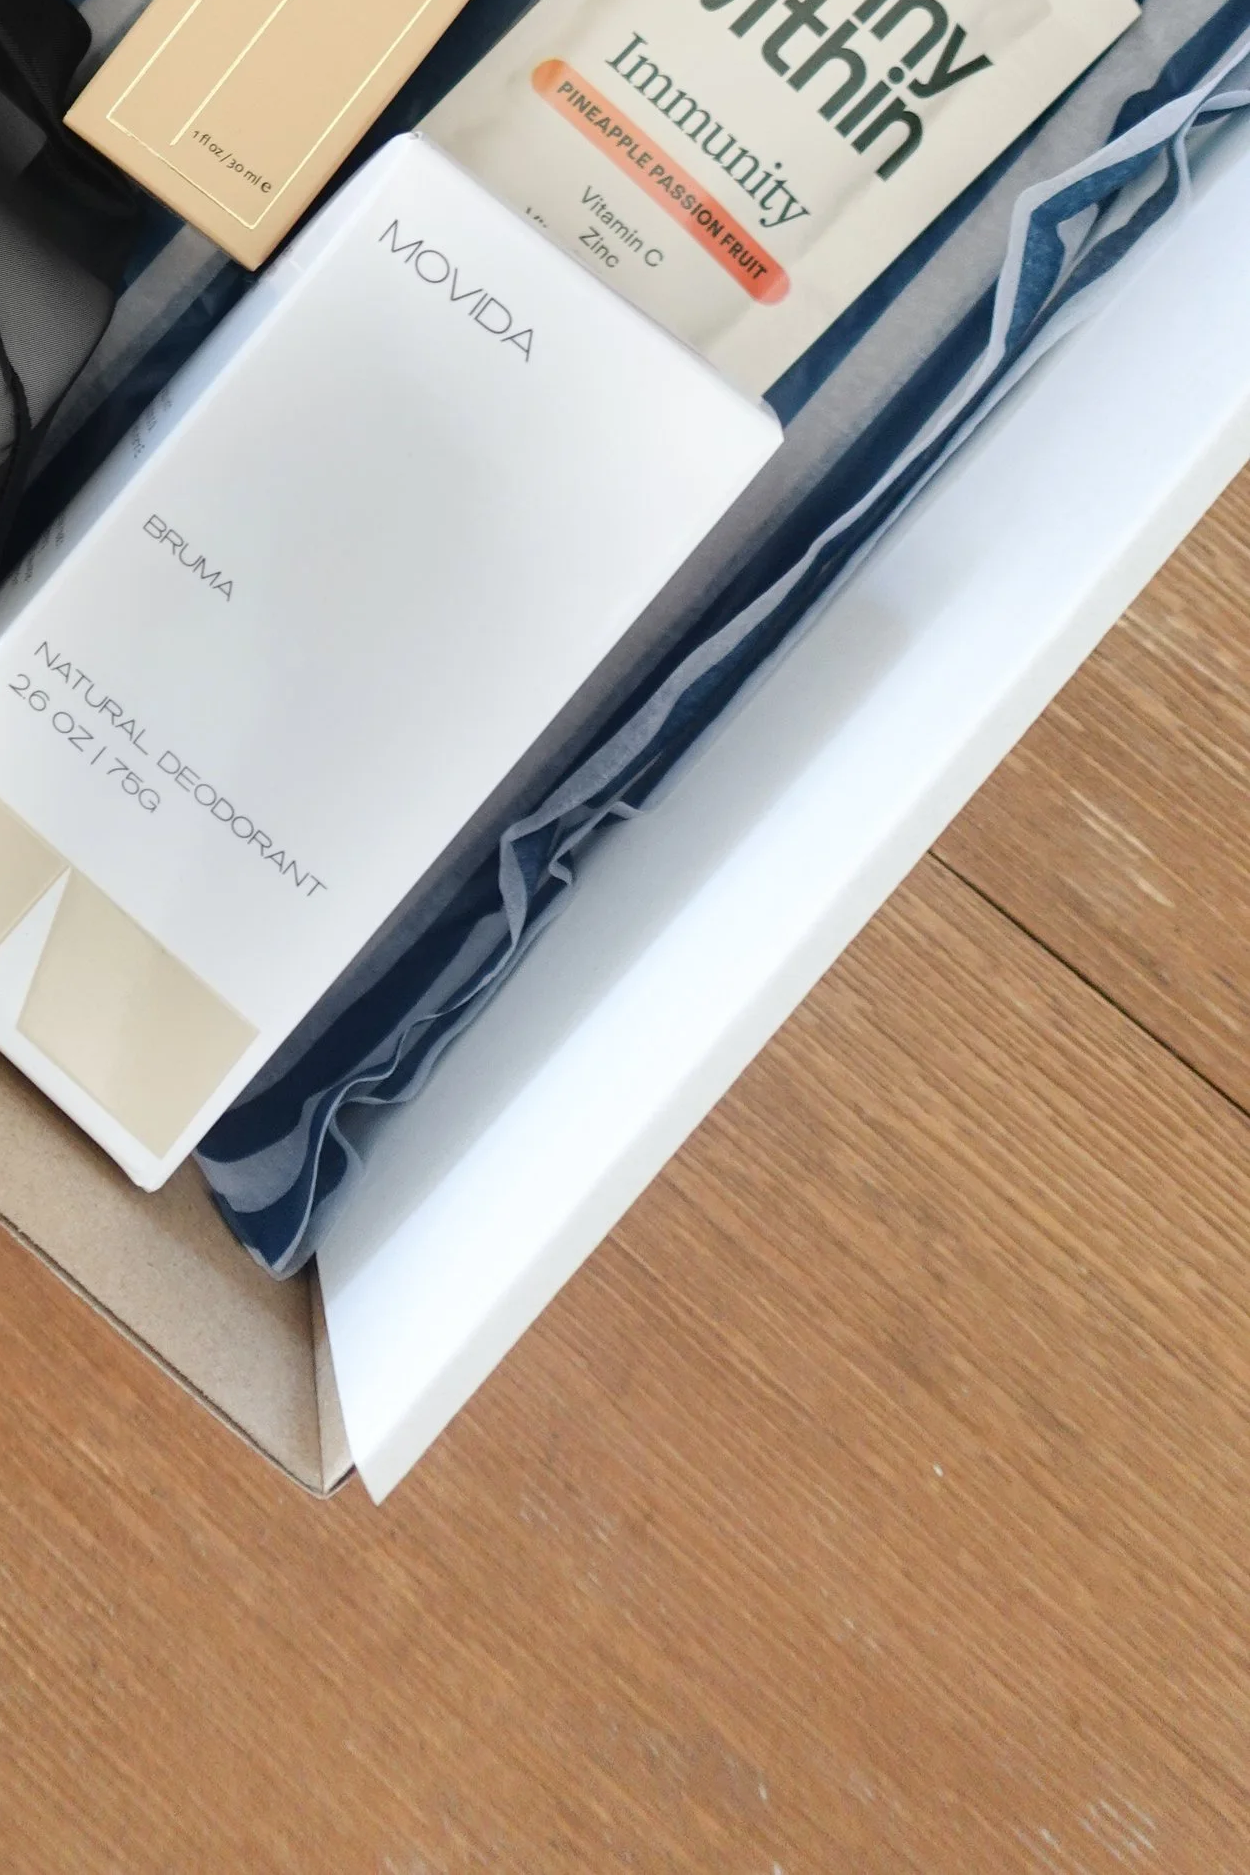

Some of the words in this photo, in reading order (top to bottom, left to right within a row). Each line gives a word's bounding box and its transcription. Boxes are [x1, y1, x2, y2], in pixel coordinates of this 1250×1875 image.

[208, 143, 225, 158] oz
[226, 158, 245, 173] 30
[243, 170, 263, 186] ml
[556, 80, 655, 170] PINEAPPLE
[648, 164, 725, 240] PASSION
[718, 233, 769, 281] FRUIT
[604, 31, 812, 229] Immunity
[578, 226, 620, 268] Zinc
[581, 185, 644, 253] Vitamin
[644, 248, 665, 268] C
[377, 219, 536, 363] MOVIDA
[143, 513, 237, 603] BRUMA
[33, 640, 149, 756] NATURAL
[156, 749, 328, 898] DEODORANT
[52, 711, 95, 753] OZ
[106, 757, 161, 813] 75G
